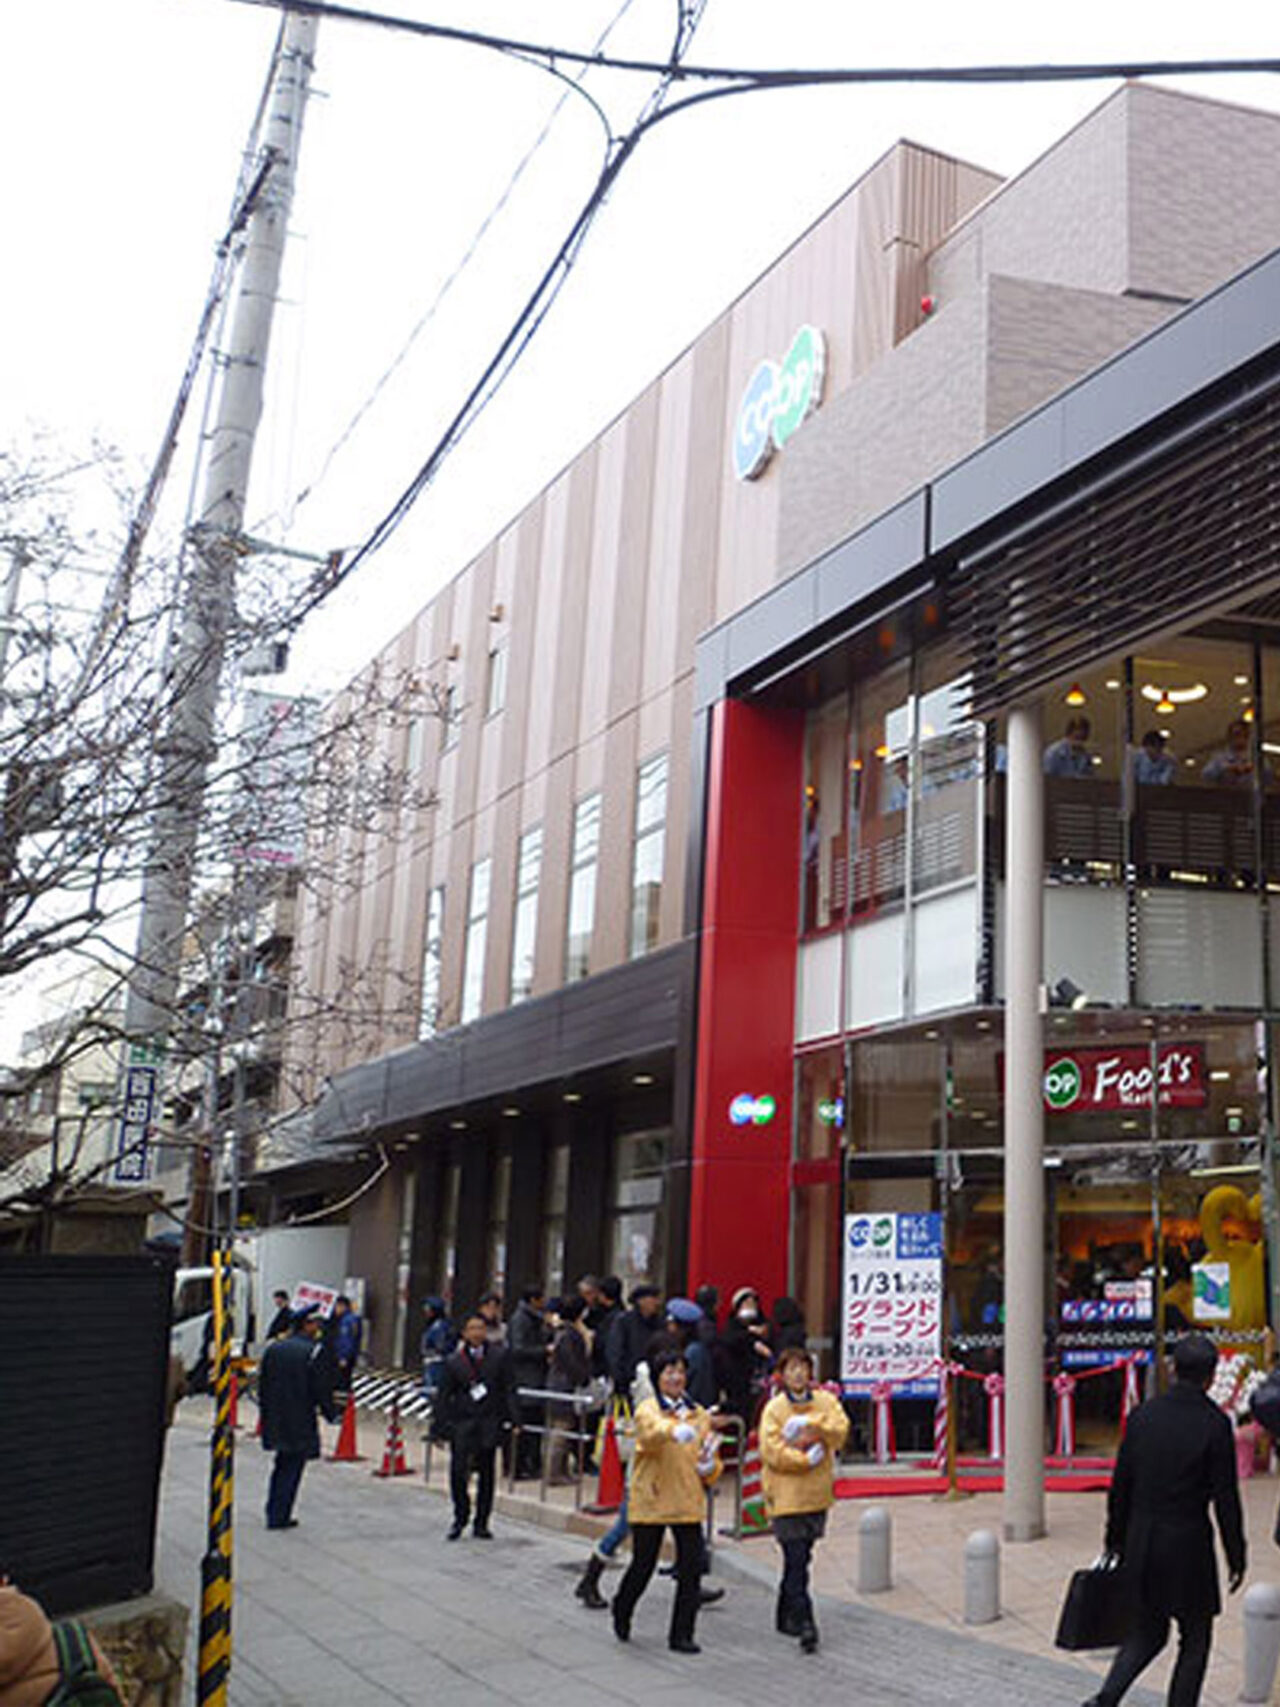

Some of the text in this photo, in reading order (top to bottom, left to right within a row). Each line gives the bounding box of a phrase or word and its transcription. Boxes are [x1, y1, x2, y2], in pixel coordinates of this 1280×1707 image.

[1044, 1053, 1193, 1103] OP Food's
[848, 1297, 937, 1320] グランド
[847, 1319, 939, 1338] オープン
